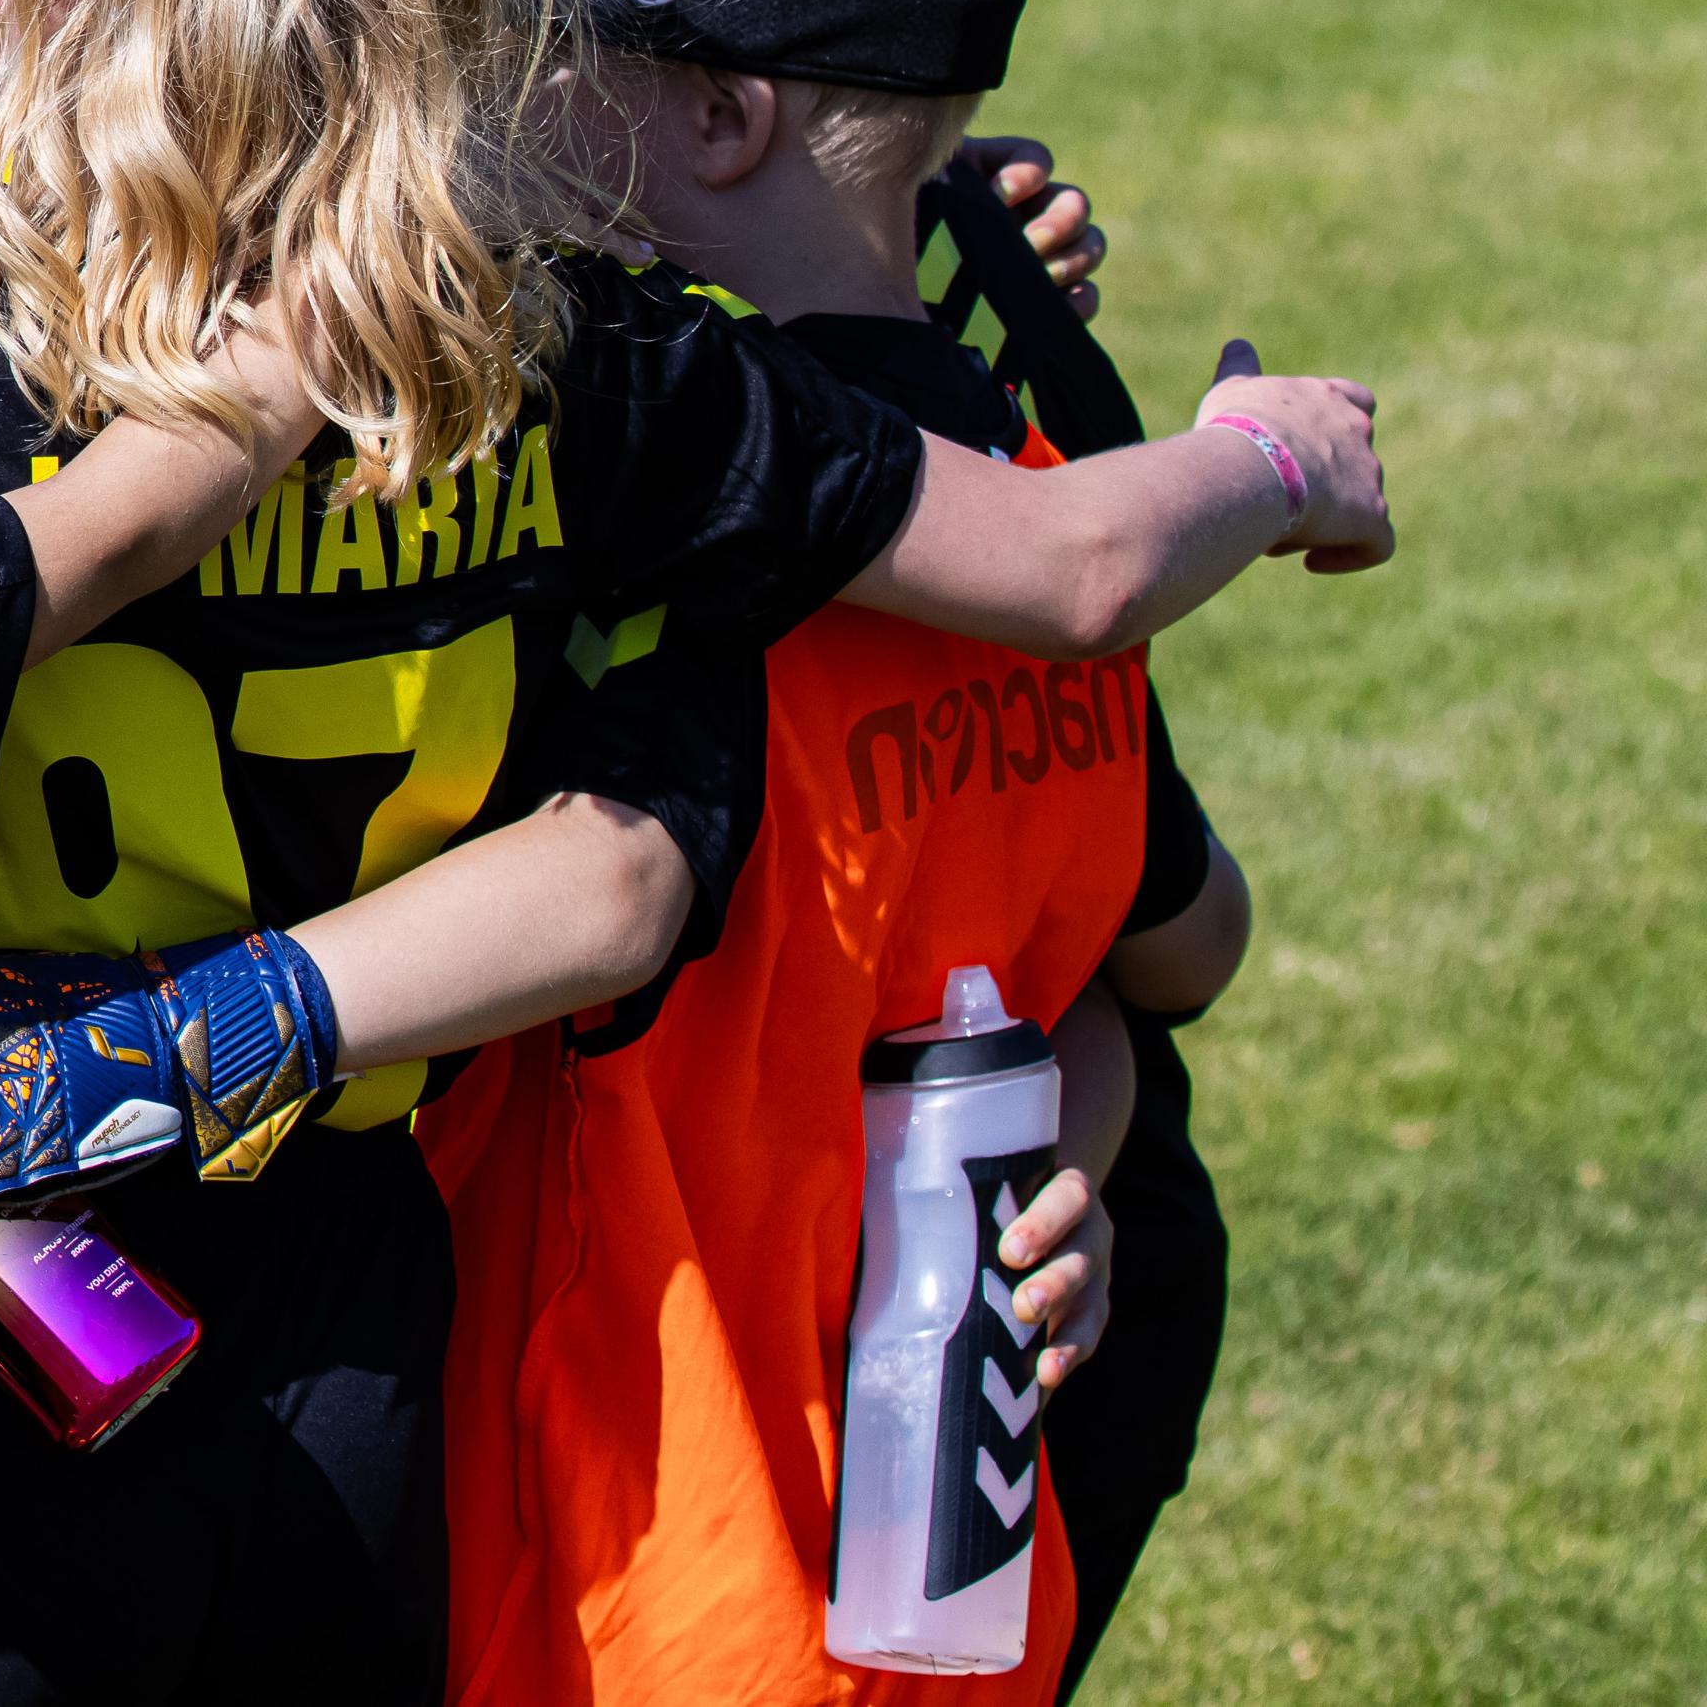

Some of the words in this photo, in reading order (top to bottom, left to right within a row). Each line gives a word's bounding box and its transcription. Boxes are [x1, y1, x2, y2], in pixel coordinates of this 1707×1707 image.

[33, 1231, 67, 1265] ALMOST
[70, 1237, 94, 1258] 200ML
[86, 1273, 106, 1291] YOU
[103, 1262, 119, 1278] DID
[116, 1256, 127, 1270] IT
[112, 1279, 134, 1298] 100ML
